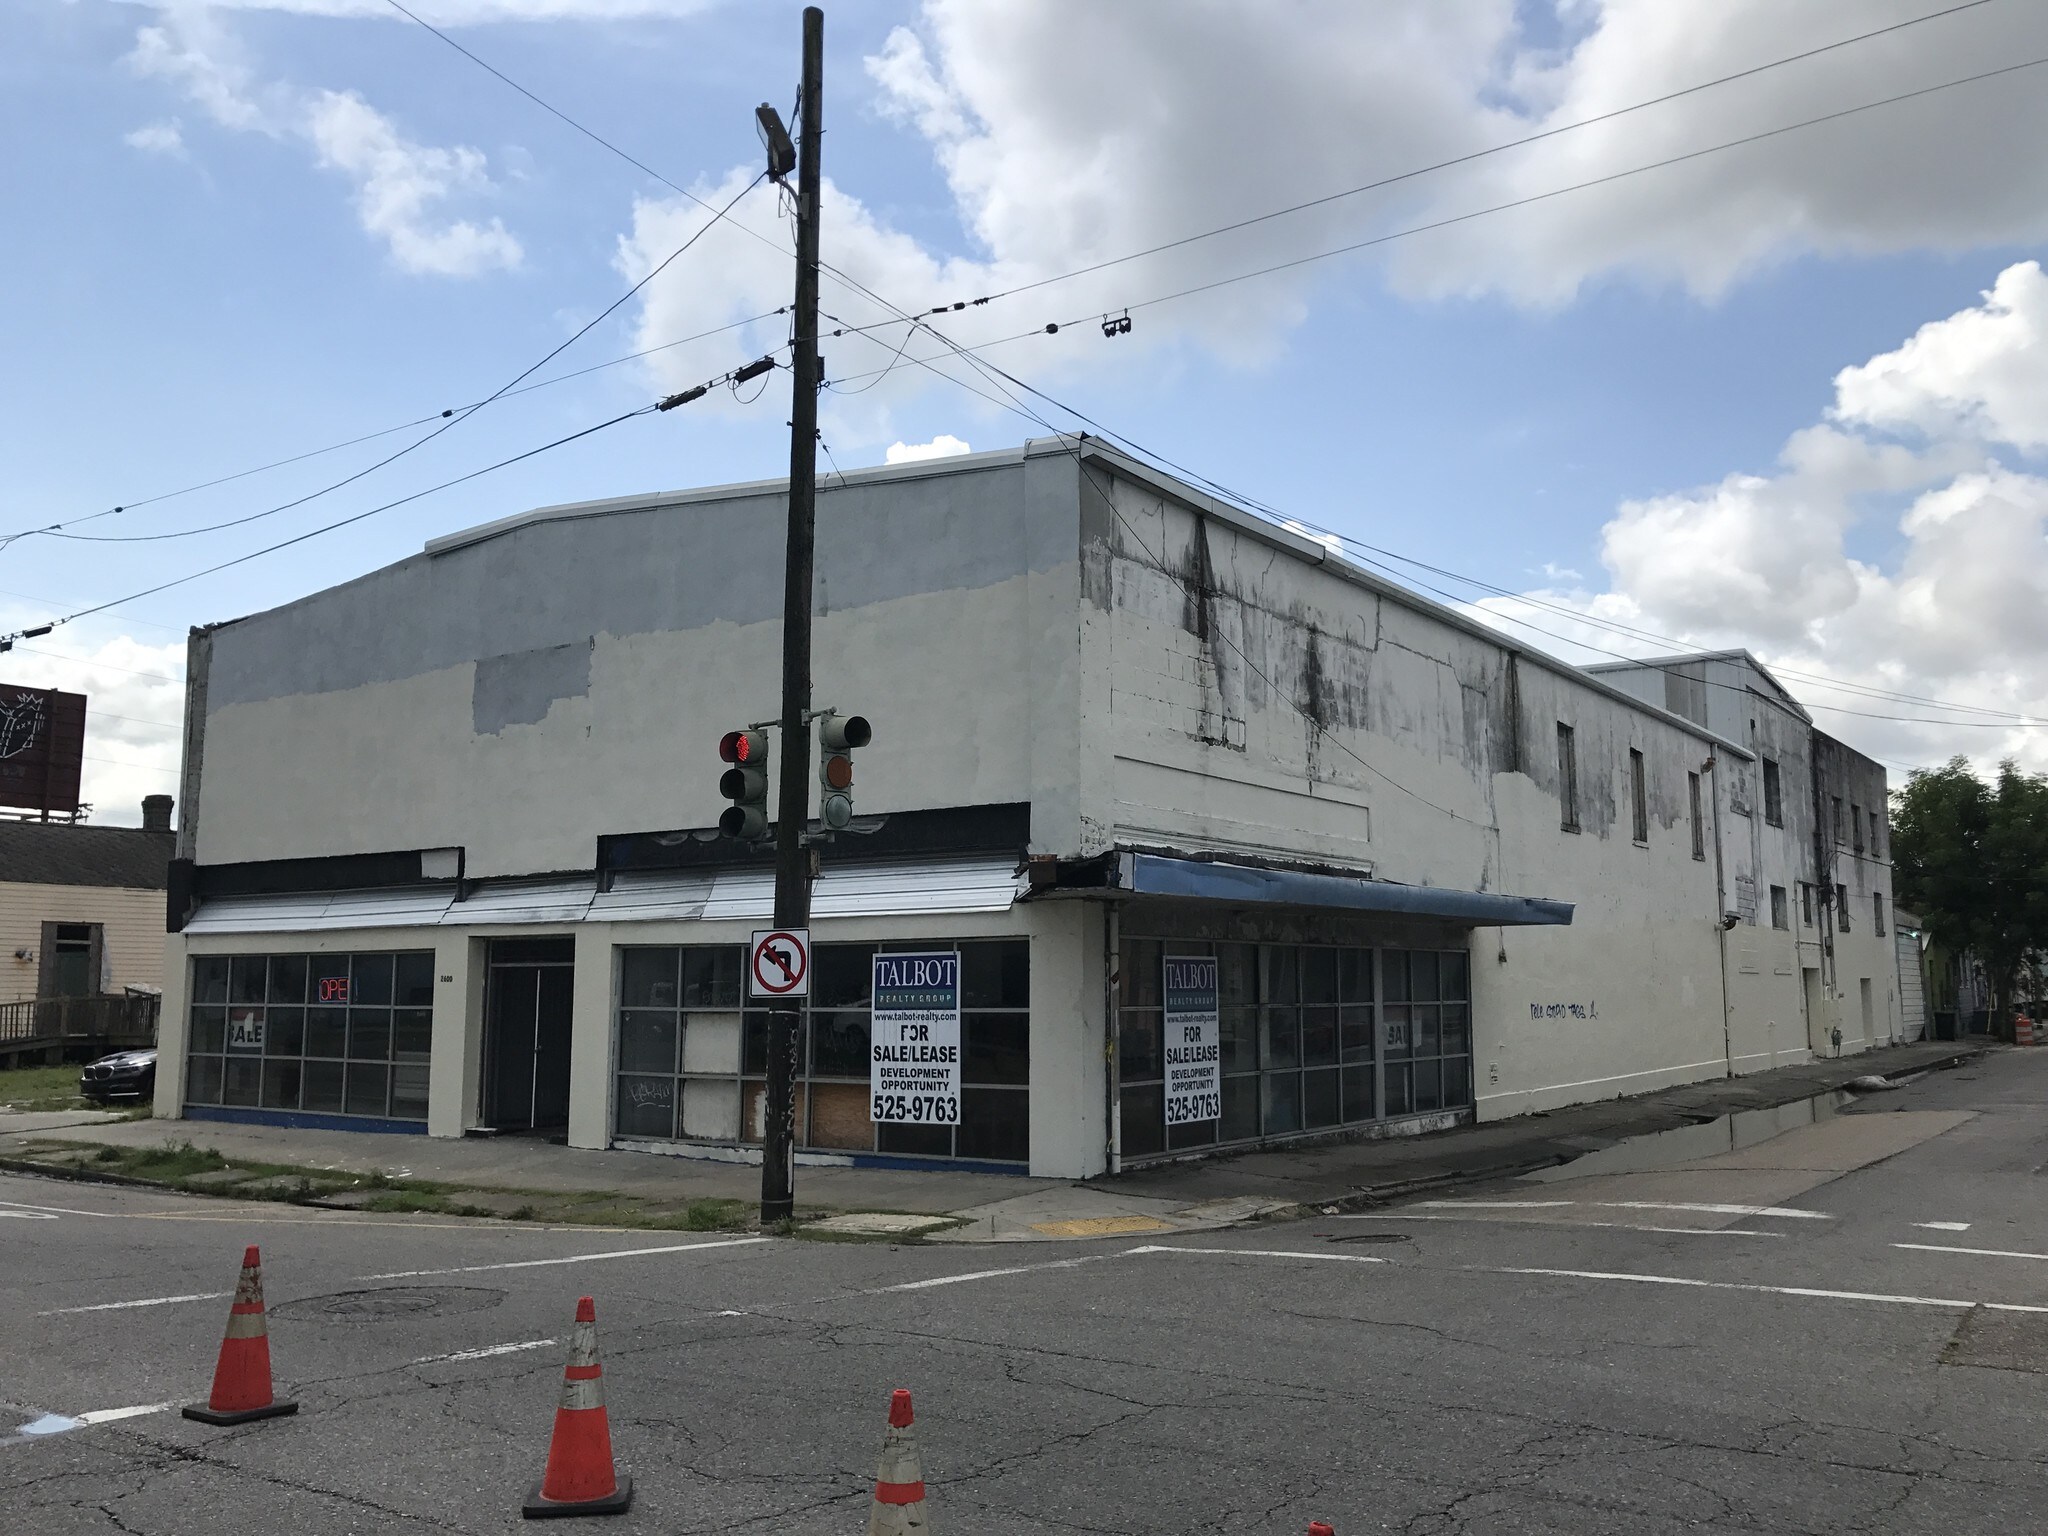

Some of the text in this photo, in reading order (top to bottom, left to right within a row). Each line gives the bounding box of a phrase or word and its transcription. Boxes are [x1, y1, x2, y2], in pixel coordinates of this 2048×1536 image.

[876, 959, 956, 987] TALBOT
[1166, 963, 1215, 989] TALBOT
[321, 979, 349, 1000] OPE
[879, 994, 951, 1003] REALTY GROUP
[1169, 997, 1192, 1006] REALTY
[874, 1011, 957, 1023] www.talbot-realty.com
[900, 1024, 929, 1042] FOR
[1183, 1026, 1201, 1043] FOR
[873, 1045, 957, 1063] SALE/LEASE
[1166, 1045, 1218, 1065] SALE/LEASE
[880, 1067, 951, 1079] DEVELOPMENT
[1171, 1067, 1215, 1080] DEVELOPMENT
[881, 1080, 950, 1091] OPPORTUNITY
[1172, 1079, 1214, 1093] OPPORTUNITY
[873, 1095, 958, 1122] 525-9763
[1167, 1092, 1219, 1123] 525-9763
